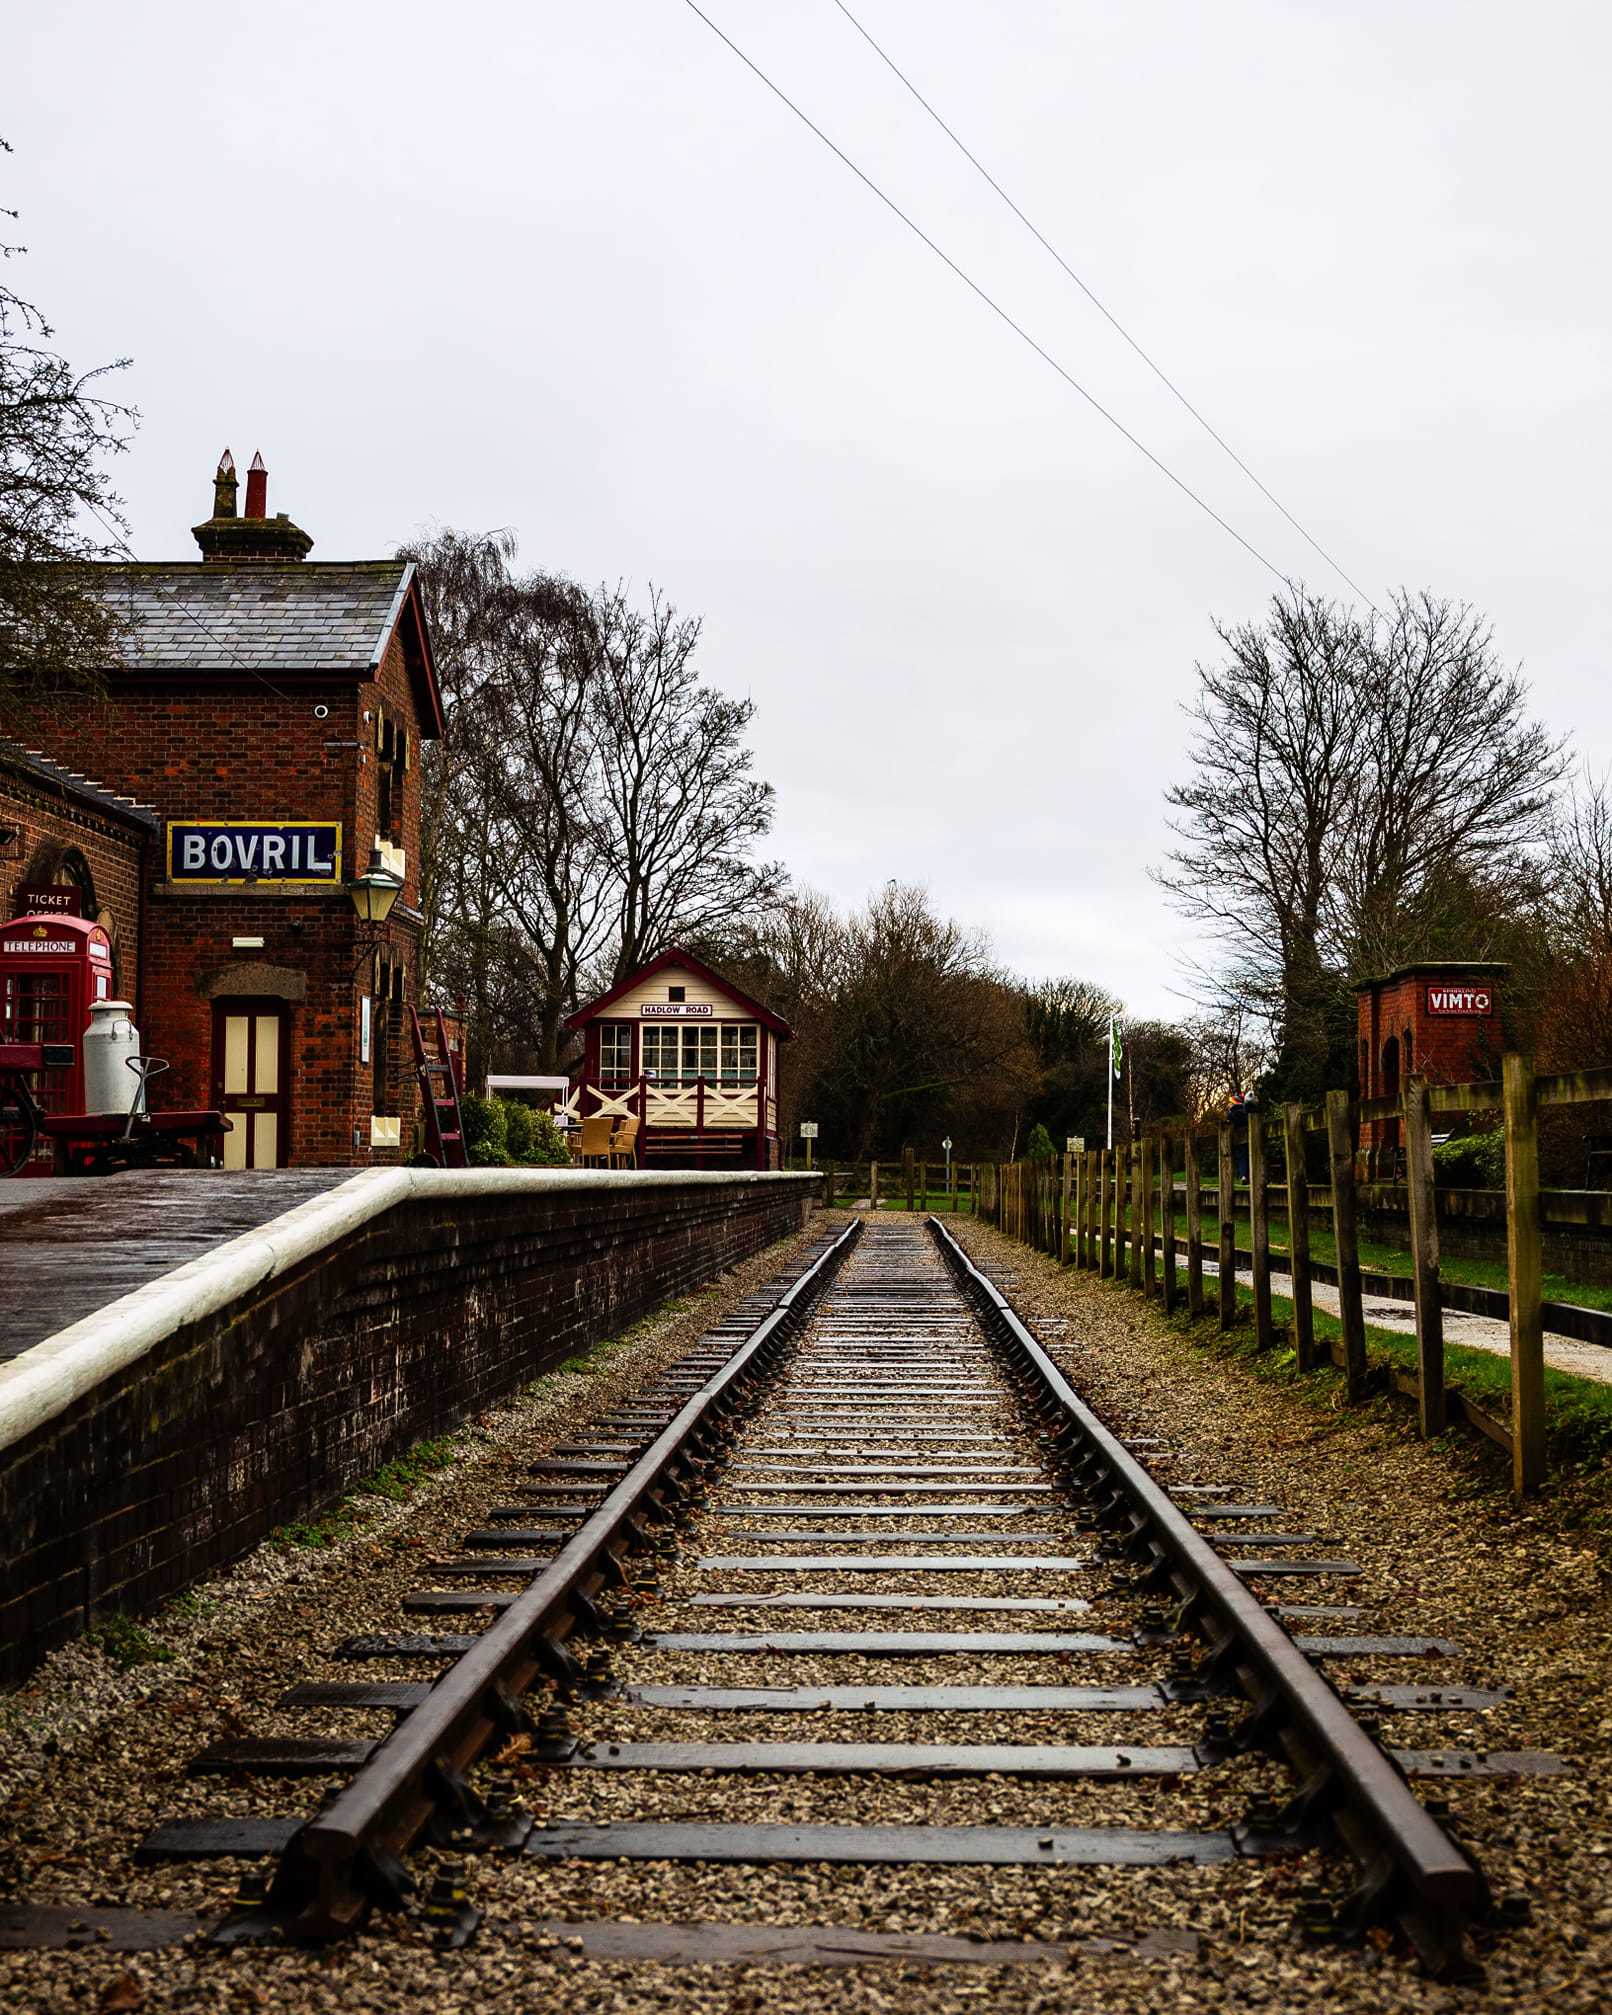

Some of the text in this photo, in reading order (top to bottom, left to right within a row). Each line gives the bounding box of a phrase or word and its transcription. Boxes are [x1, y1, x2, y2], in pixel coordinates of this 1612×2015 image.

[183, 835, 332, 870] BOVRIL
[27, 894, 71, 906] TICKET
[6, 941, 74, 952] TELEPHONE
[1431, 993, 1489, 1009] VIMTO
[644, 1006, 709, 1014] HADLOW ROAD
